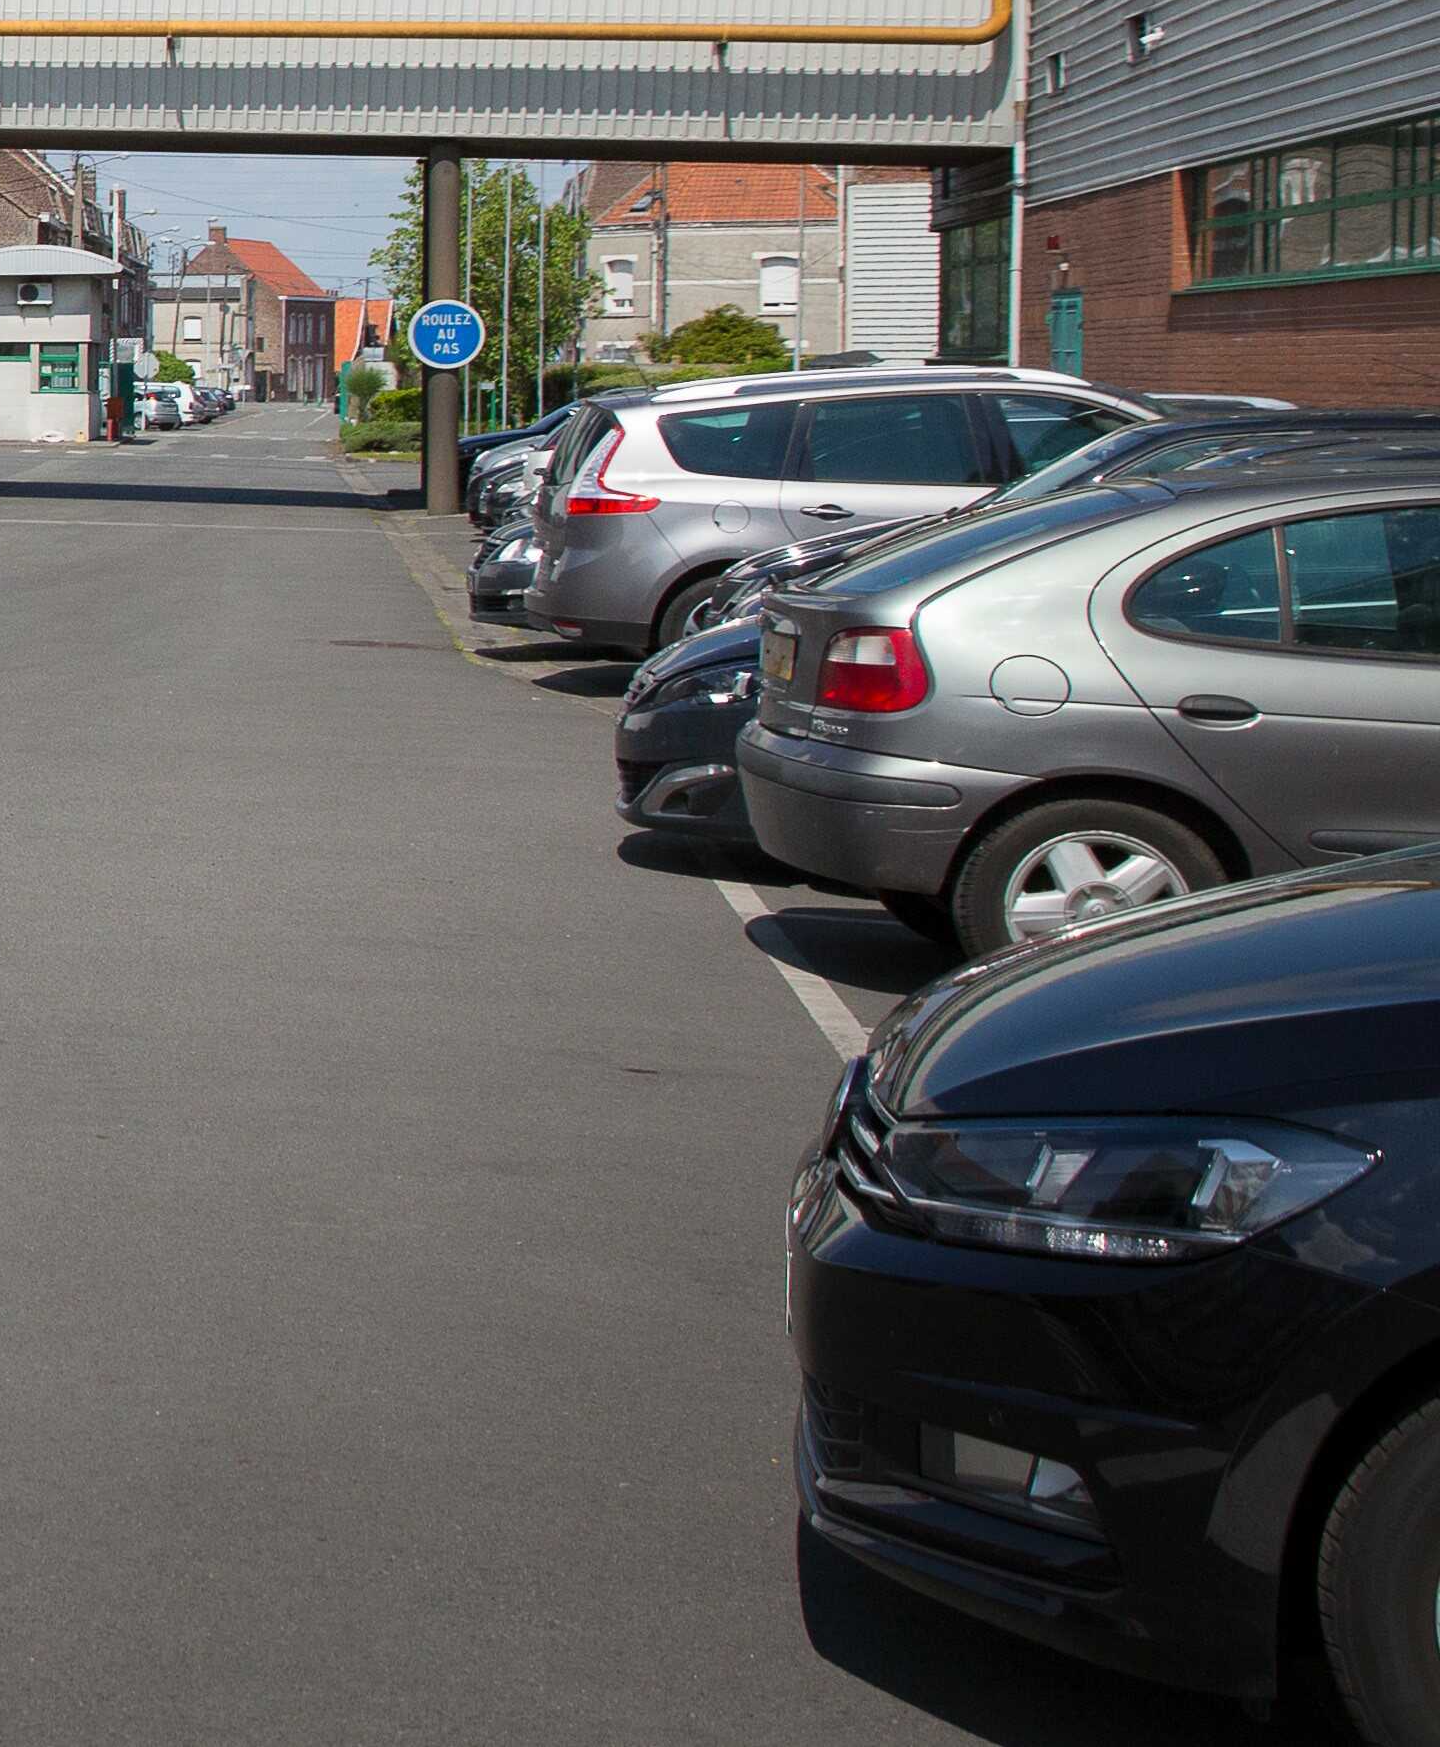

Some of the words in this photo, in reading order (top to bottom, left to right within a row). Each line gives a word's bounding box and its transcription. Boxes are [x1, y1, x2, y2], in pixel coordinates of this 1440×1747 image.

[422, 313, 472, 326] ROULEZ
[437, 328, 456, 340] AU
[433, 342, 460, 355] PAS
